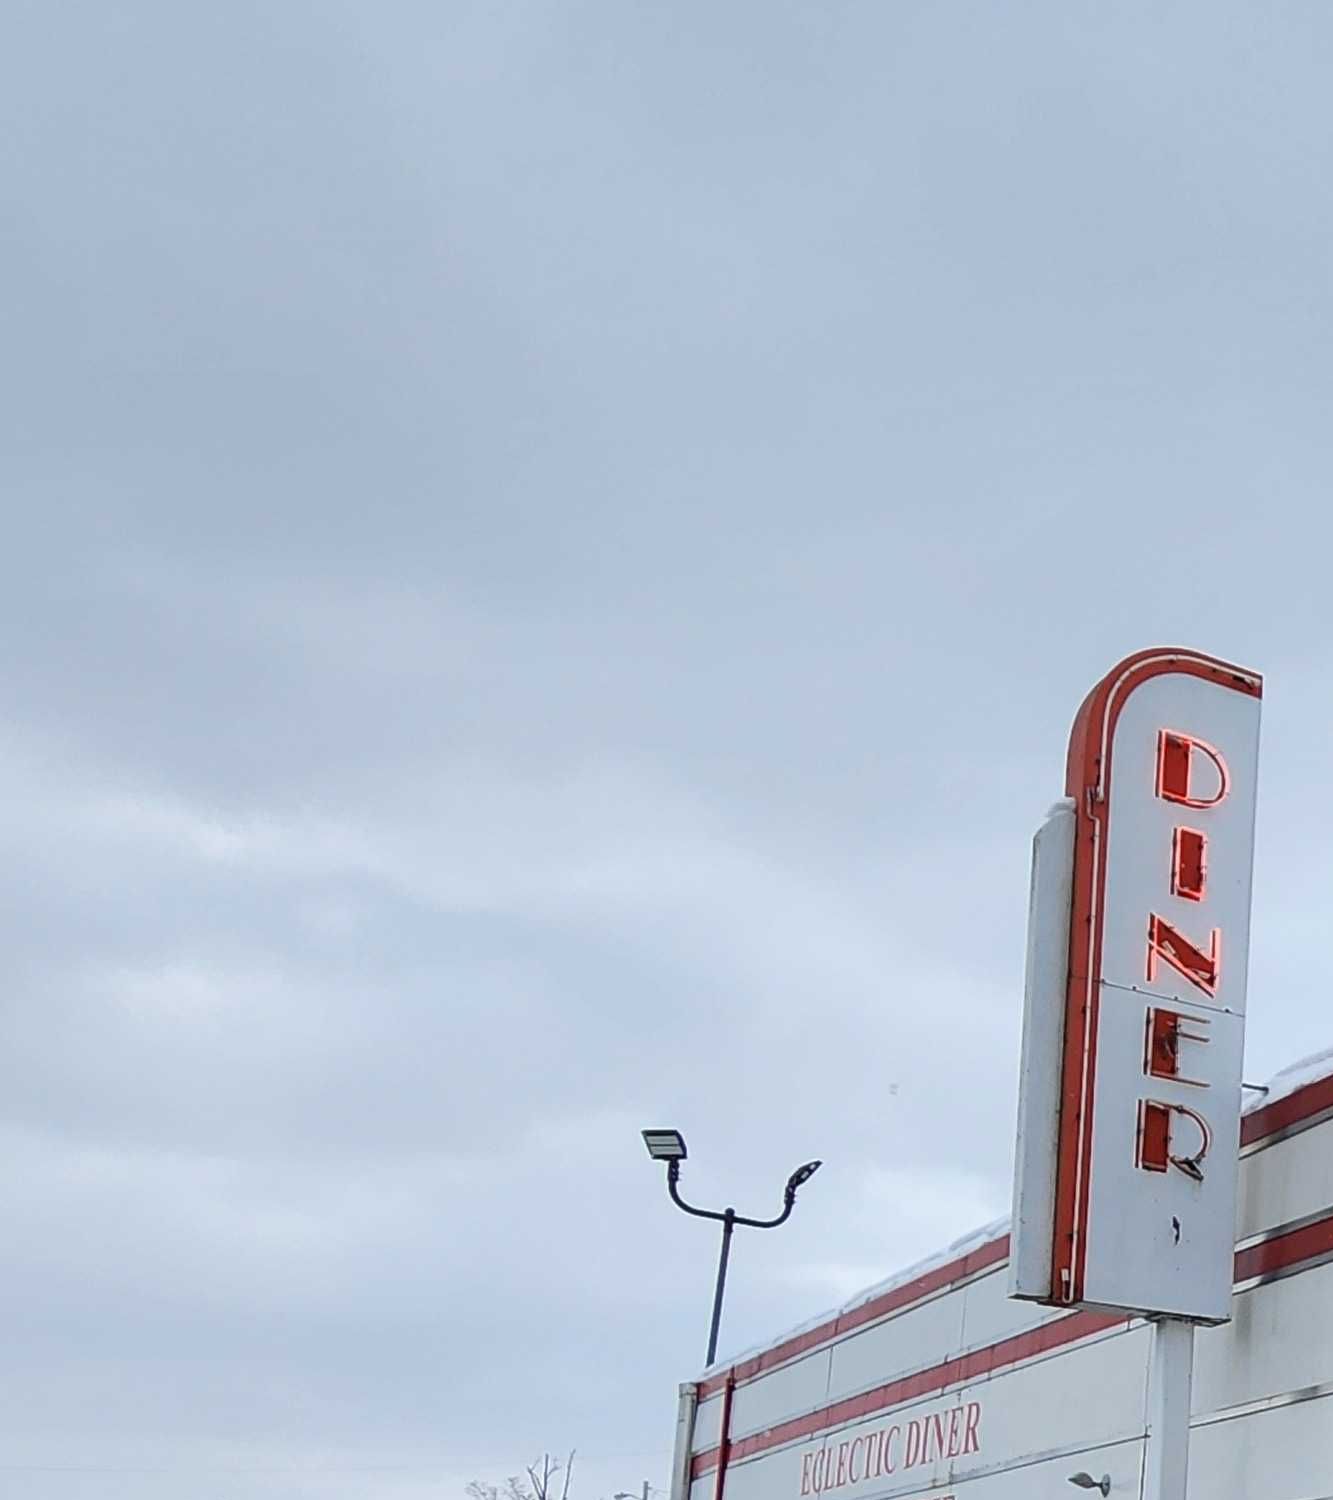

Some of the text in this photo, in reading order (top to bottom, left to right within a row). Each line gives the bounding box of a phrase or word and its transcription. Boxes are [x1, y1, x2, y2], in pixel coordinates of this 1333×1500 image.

[1135, 728, 1231, 1181] DINER
[801, 1402, 980, 1496] ECLECTIC DINER
